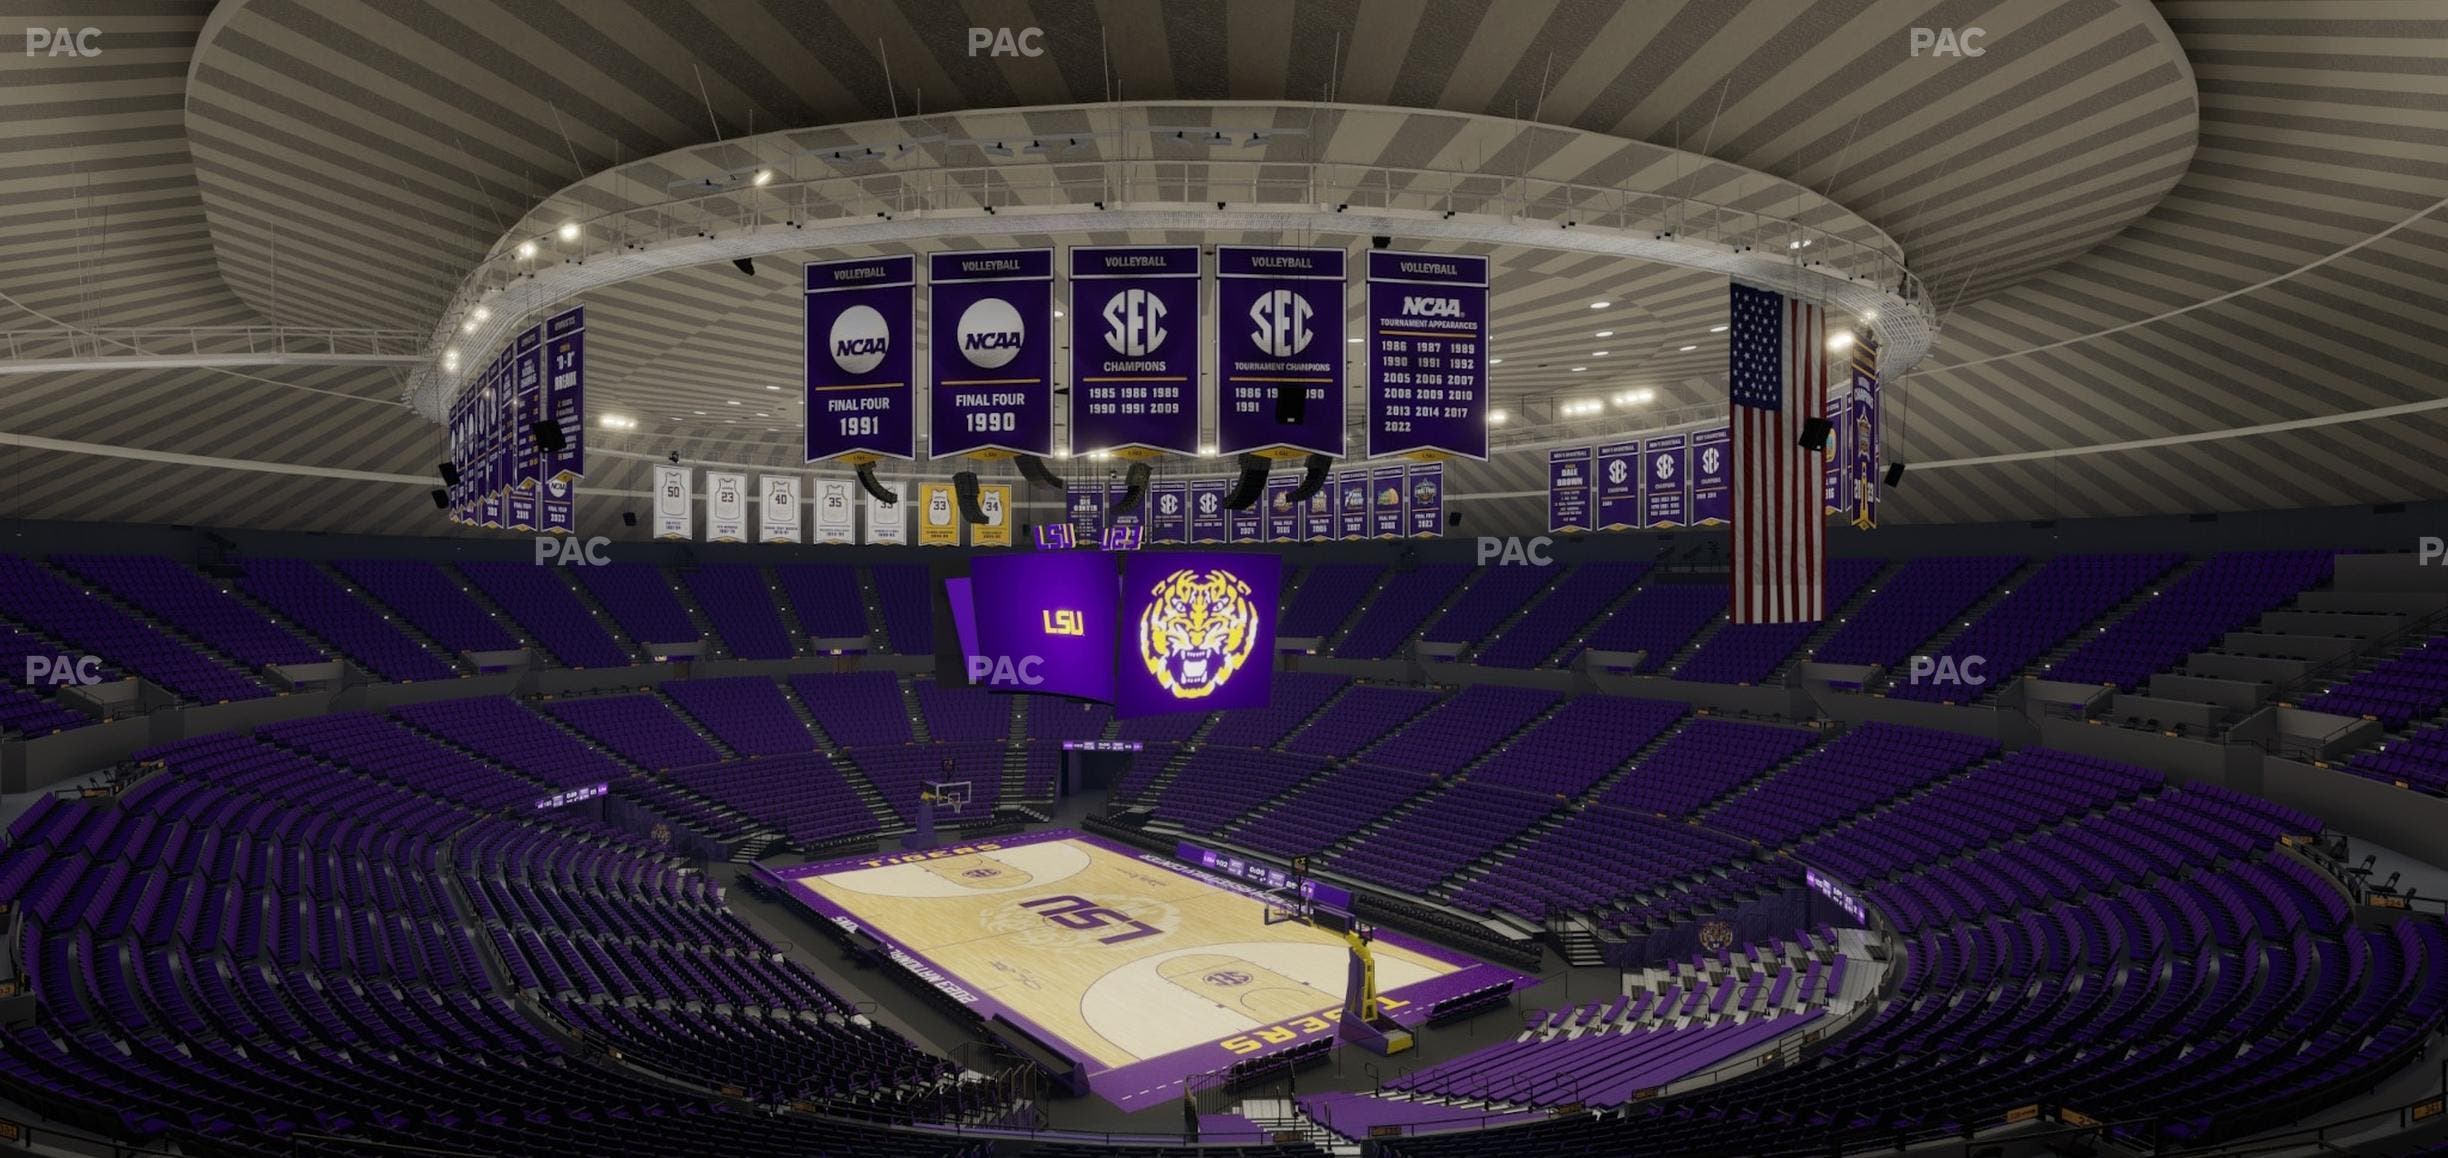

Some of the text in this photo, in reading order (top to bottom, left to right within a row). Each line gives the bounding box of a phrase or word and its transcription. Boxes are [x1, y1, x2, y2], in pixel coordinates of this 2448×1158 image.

[962, 259, 1020, 272] VOLLEYBALL
[1105, 256, 1167, 268] VOLLEYBALL
[1252, 256, 1313, 269] VOLLEYBALL
[1400, 262, 1458, 275] VOLLEYBALL
[834, 266, 886, 281] VOLLEYBALL
[1402, 296, 1462, 318] NCAA
[1102, 288, 1168, 357] SEC
[1249, 289, 1314, 357] SEC
[1380, 318, 1478, 331] TOURNAMENT APPEARANCES
[836, 337, 887, 357] NCAA
[965, 331, 1021, 351] NCAA
[1381, 340, 1475, 354] 1986 1987 1989
[1103, 361, 1166, 372] CHAMPIONS
[1235, 362, 1330, 372] TOURNAMENT CHAMPIONS
[1383, 356, 1474, 369] 1990 1991 1992
[1383, 373, 1474, 386] 2005 2006 2007
[956, 392, 1025, 407] FINAL FOUR
[1089, 387, 1179, 399] 1985 1986 1989
[1235, 387, 1262, 399] 1986
[1305, 388, 1325, 400] 990
[1384, 388, 1473, 401] 2008 2009 2010
[828, 397, 890, 413] FINAL FOUR
[1089, 403, 1179, 414] 1990 1991 2009
[1236, 402, 1260, 413] 1991
[1386, 405, 1468, 418] 2013 2014 2017
[840, 416, 879, 436] 1991
[966, 412, 1016, 432] 1990
[1385, 421, 1412, 433] 2022
[1656, 453, 1675, 480] SEC
[1702, 447, 1720, 474] SEC
[1608, 458, 1628, 484] SEC
[667, 486, 680, 498] 50
[721, 492, 734, 503] 23
[775, 494, 787, 505] 40
[828, 497, 842, 508] 35
[933, 500, 947, 511] 33
[1159, 493, 1178, 515] SEC
[1199, 491, 1218, 514] SEC
[985, 501, 999, 512] 34
[1043, 609, 1084, 636] LSU
[1018, 895, 1164, 945] LSU
[1220, 996, 1411, 1055] TERS
